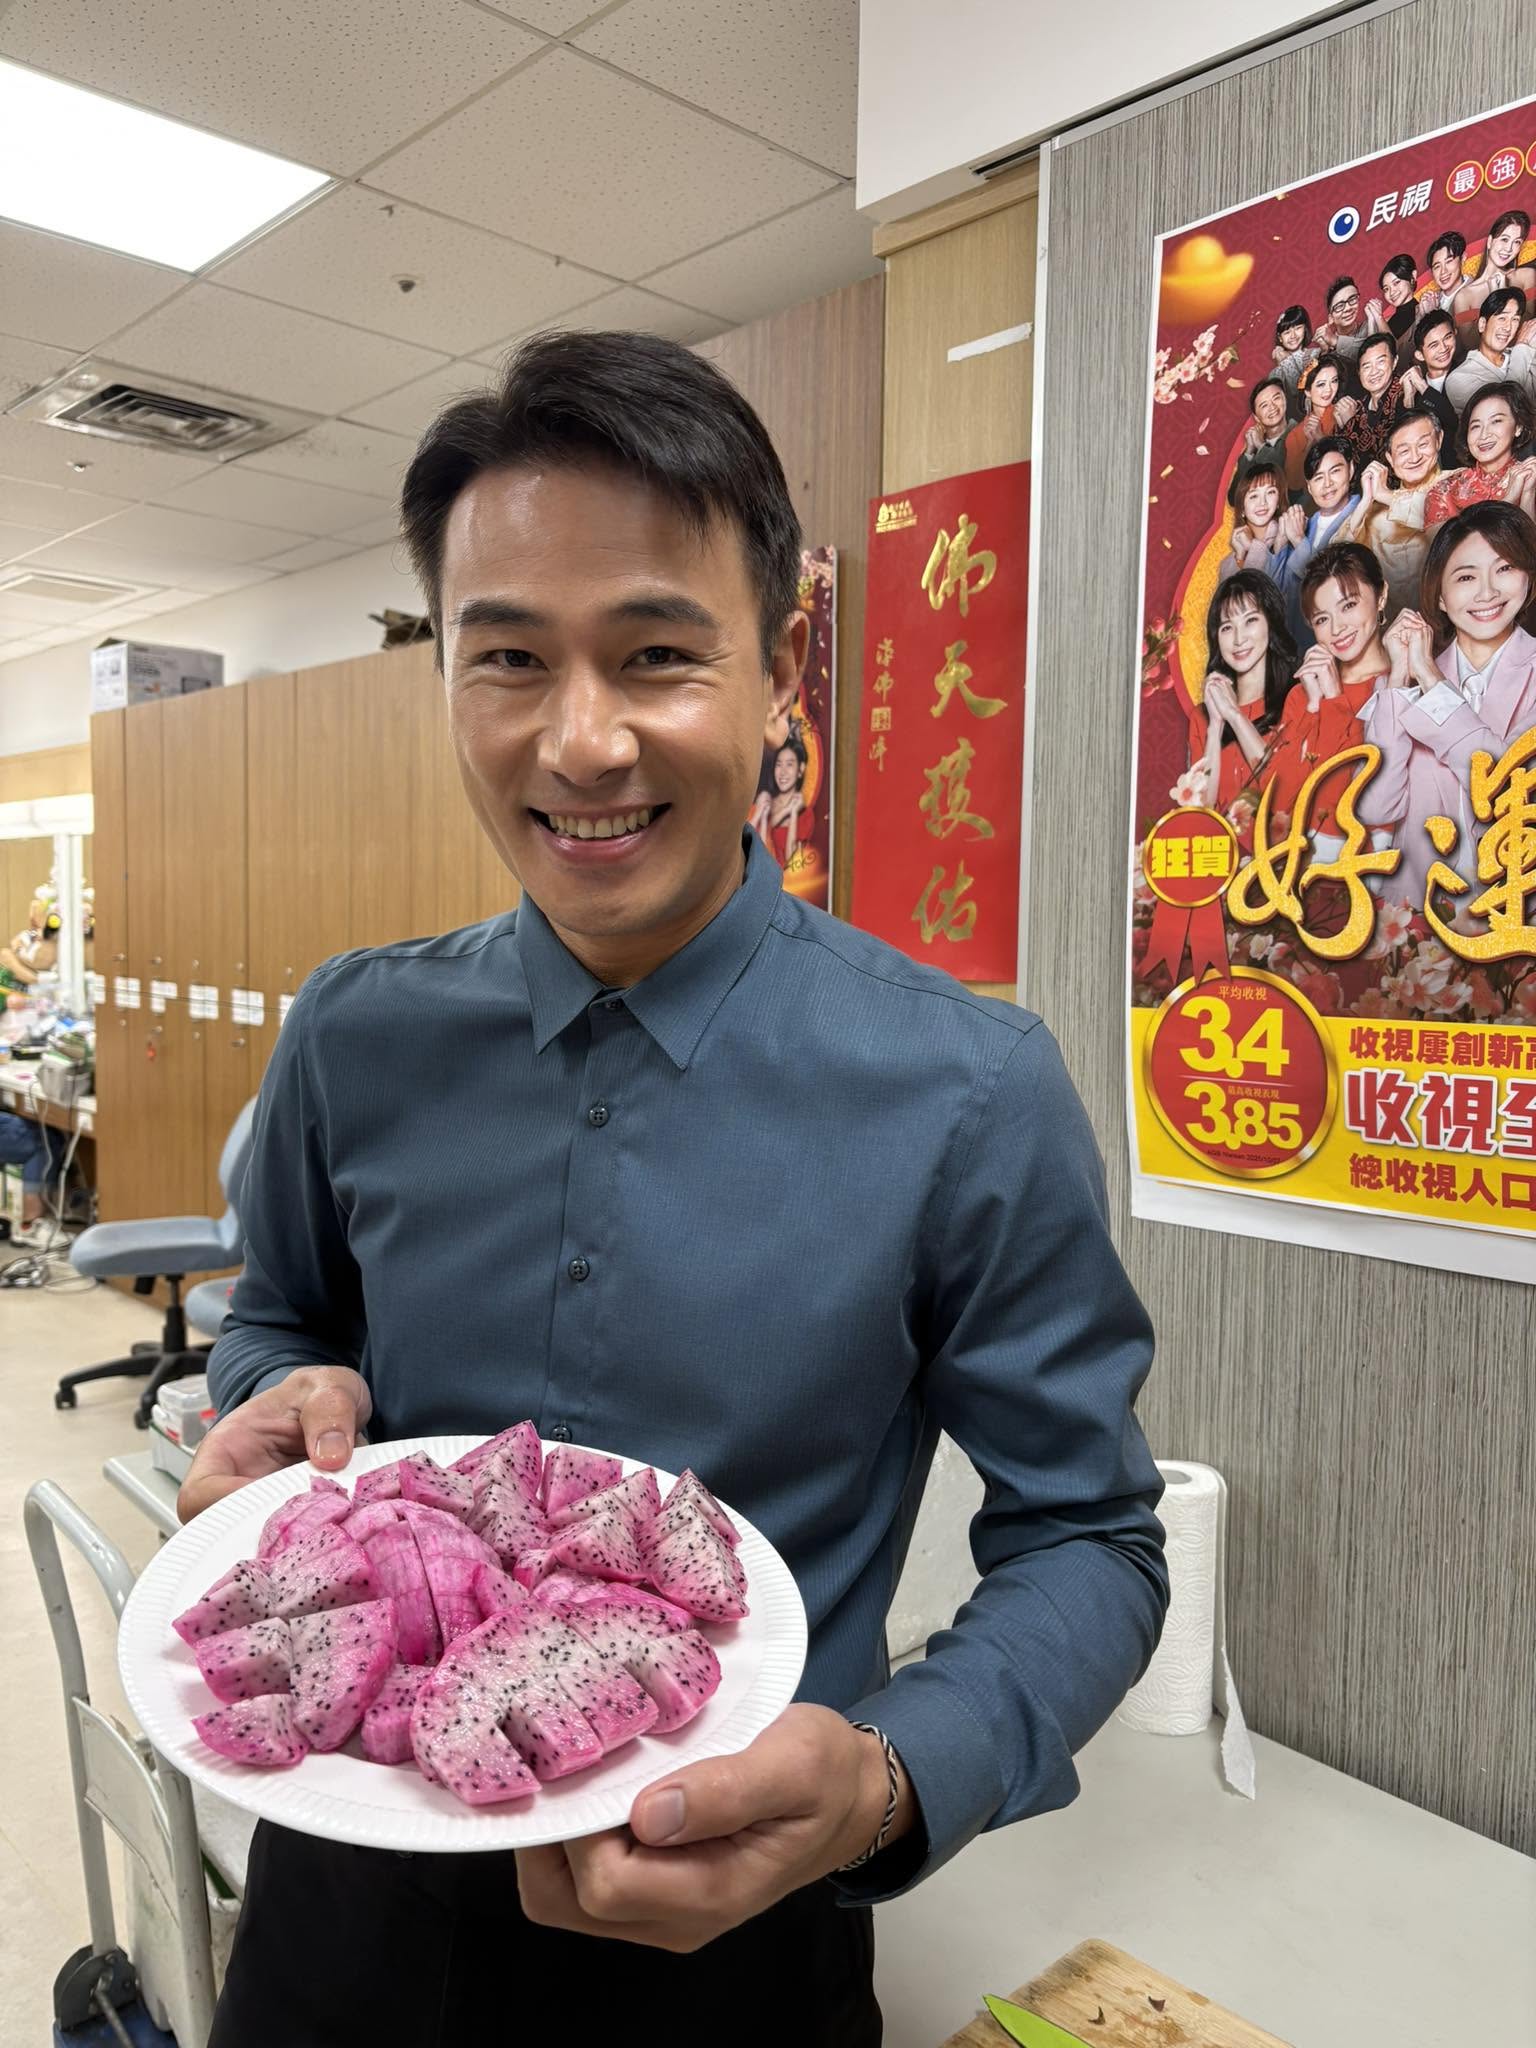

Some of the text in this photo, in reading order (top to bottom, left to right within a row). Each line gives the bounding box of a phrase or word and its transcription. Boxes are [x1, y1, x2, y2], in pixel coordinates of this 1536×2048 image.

[1366, 154, 1536, 232] 民視 最強
[1151, 835, 1230, 878] 狂賀
[1227, 726, 1536, 963] 好運
[1218, 985, 1268, 1000] 平均收視
[1179, 995, 1290, 1078] 3.4
[1184, 1080, 1303, 1149] 3.85
[1350, 1153, 1536, 1211] 總收視人口
